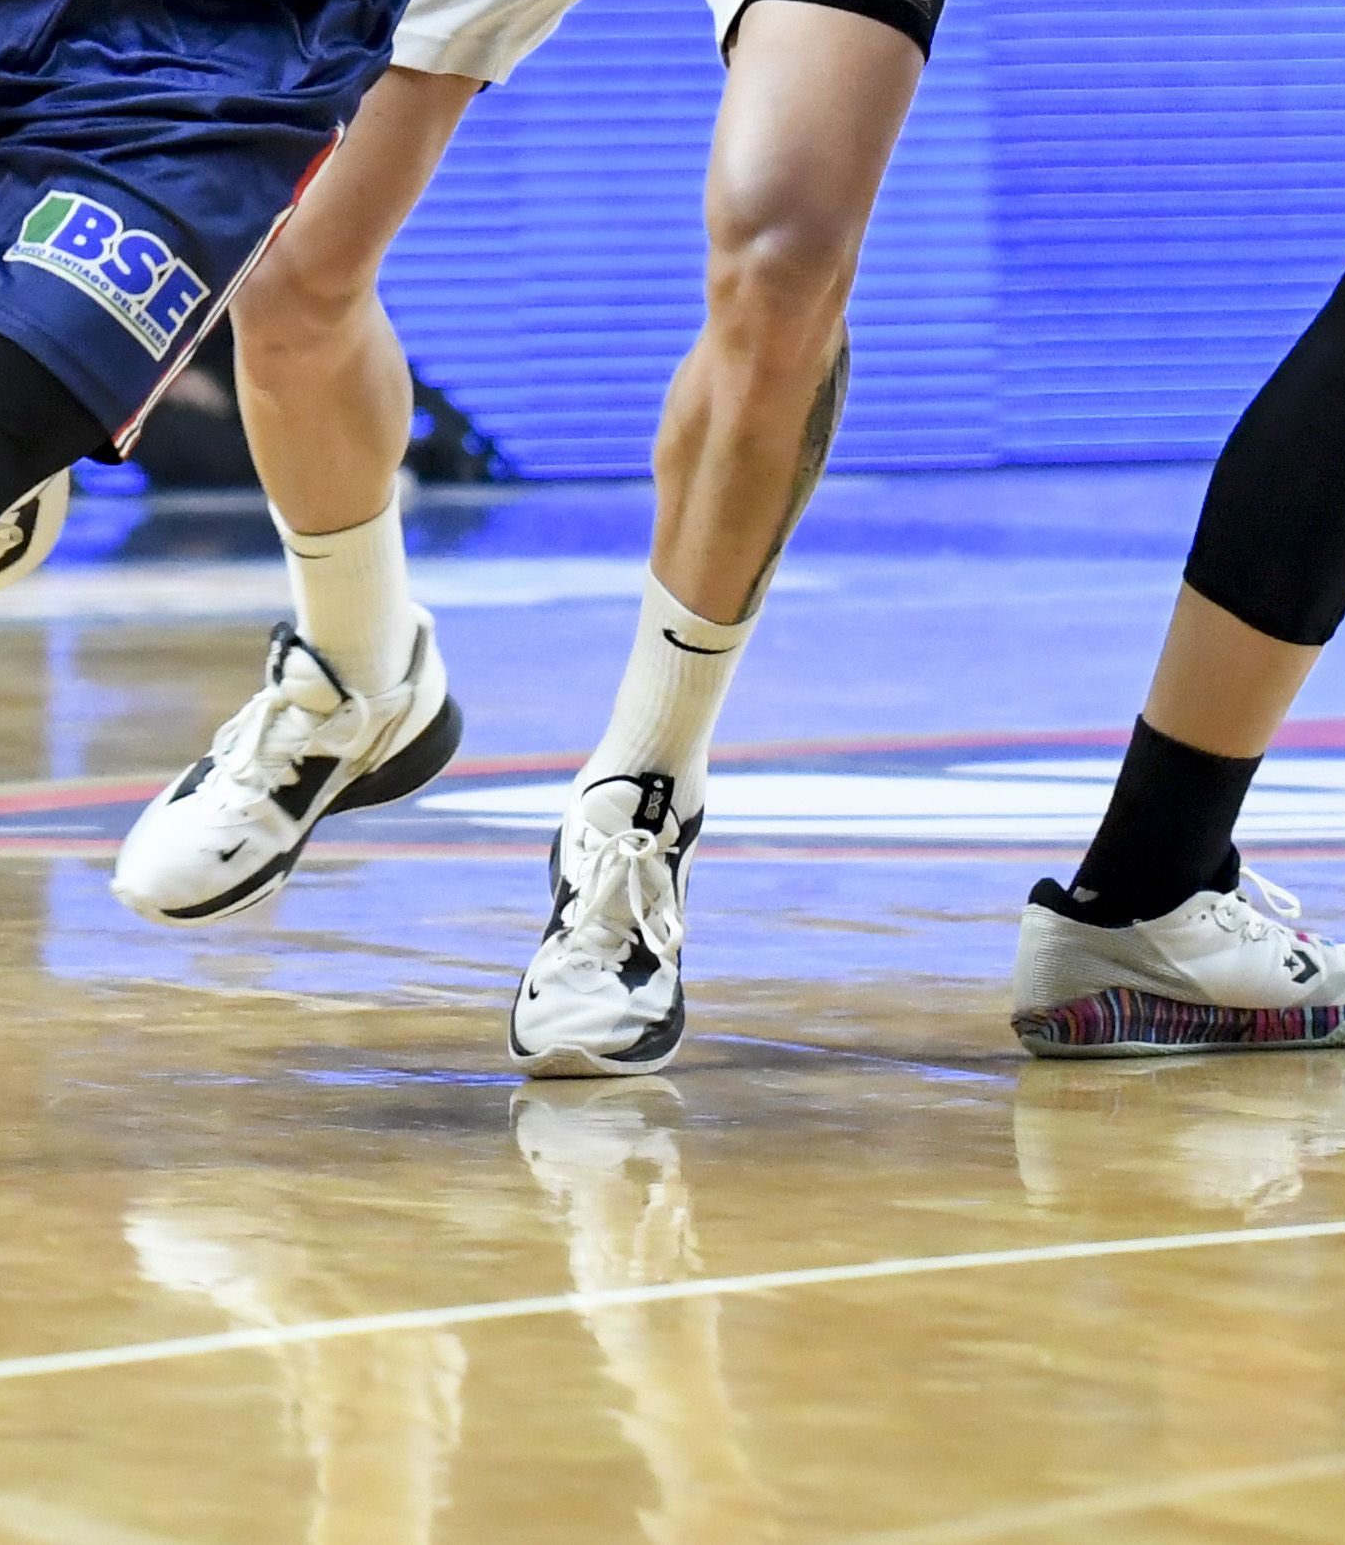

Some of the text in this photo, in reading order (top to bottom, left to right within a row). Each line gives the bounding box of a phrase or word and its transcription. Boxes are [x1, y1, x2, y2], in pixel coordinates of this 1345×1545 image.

[50, 202, 204, 336] BSE
[112, 291, 133, 314] DEL
[134, 311, 167, 349] ESTERO
